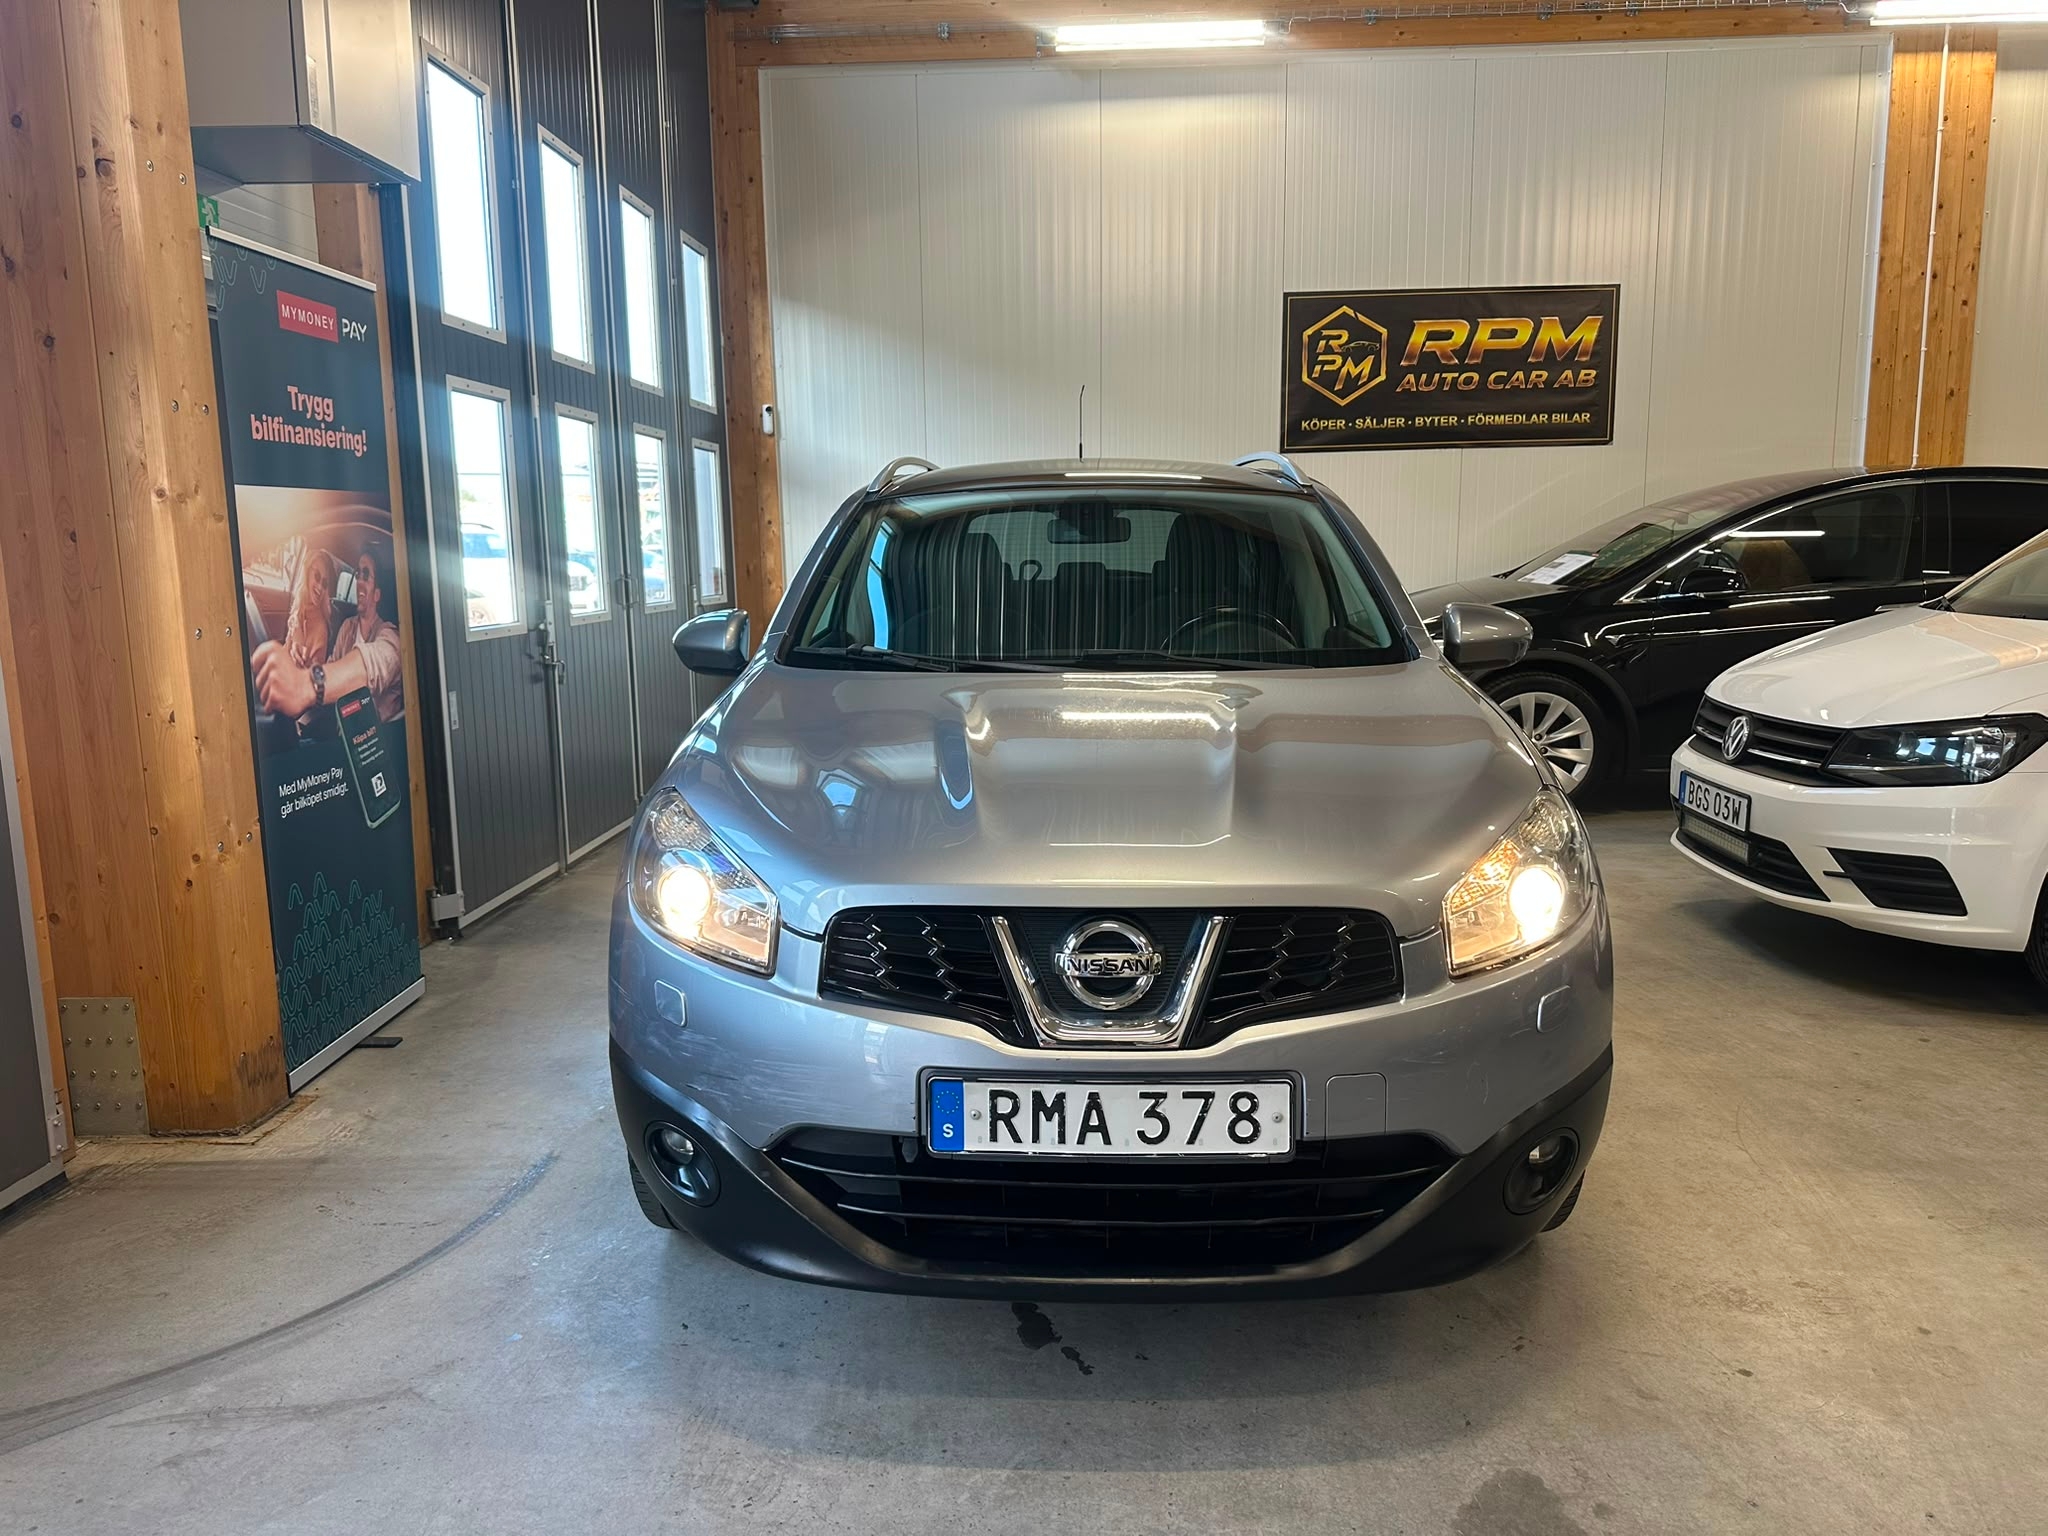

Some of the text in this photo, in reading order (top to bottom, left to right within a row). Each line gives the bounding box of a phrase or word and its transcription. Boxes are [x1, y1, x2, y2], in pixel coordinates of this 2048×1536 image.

[281, 304, 367, 343] MYMONEY PAY
[1400, 315, 1604, 367] RPM
[1396, 369, 1598, 393] AUTO CAR AB
[287, 385, 334, 422] Trygg
[250, 414, 367, 458] bilfinansiering!
[1301, 412, 1591, 431] KÖPER SÄLJER BYTER FÖRMEDLAR BILAR
[279, 767, 343, 797] Med MyMoney Pay
[1688, 780, 1710, 812] BGS
[281, 802, 293, 818] går
[295, 792, 323, 810] bilköpet
[1067, 958, 1150, 972] NISSAN
[942, 1088, 1262, 1146] S RMA 378
